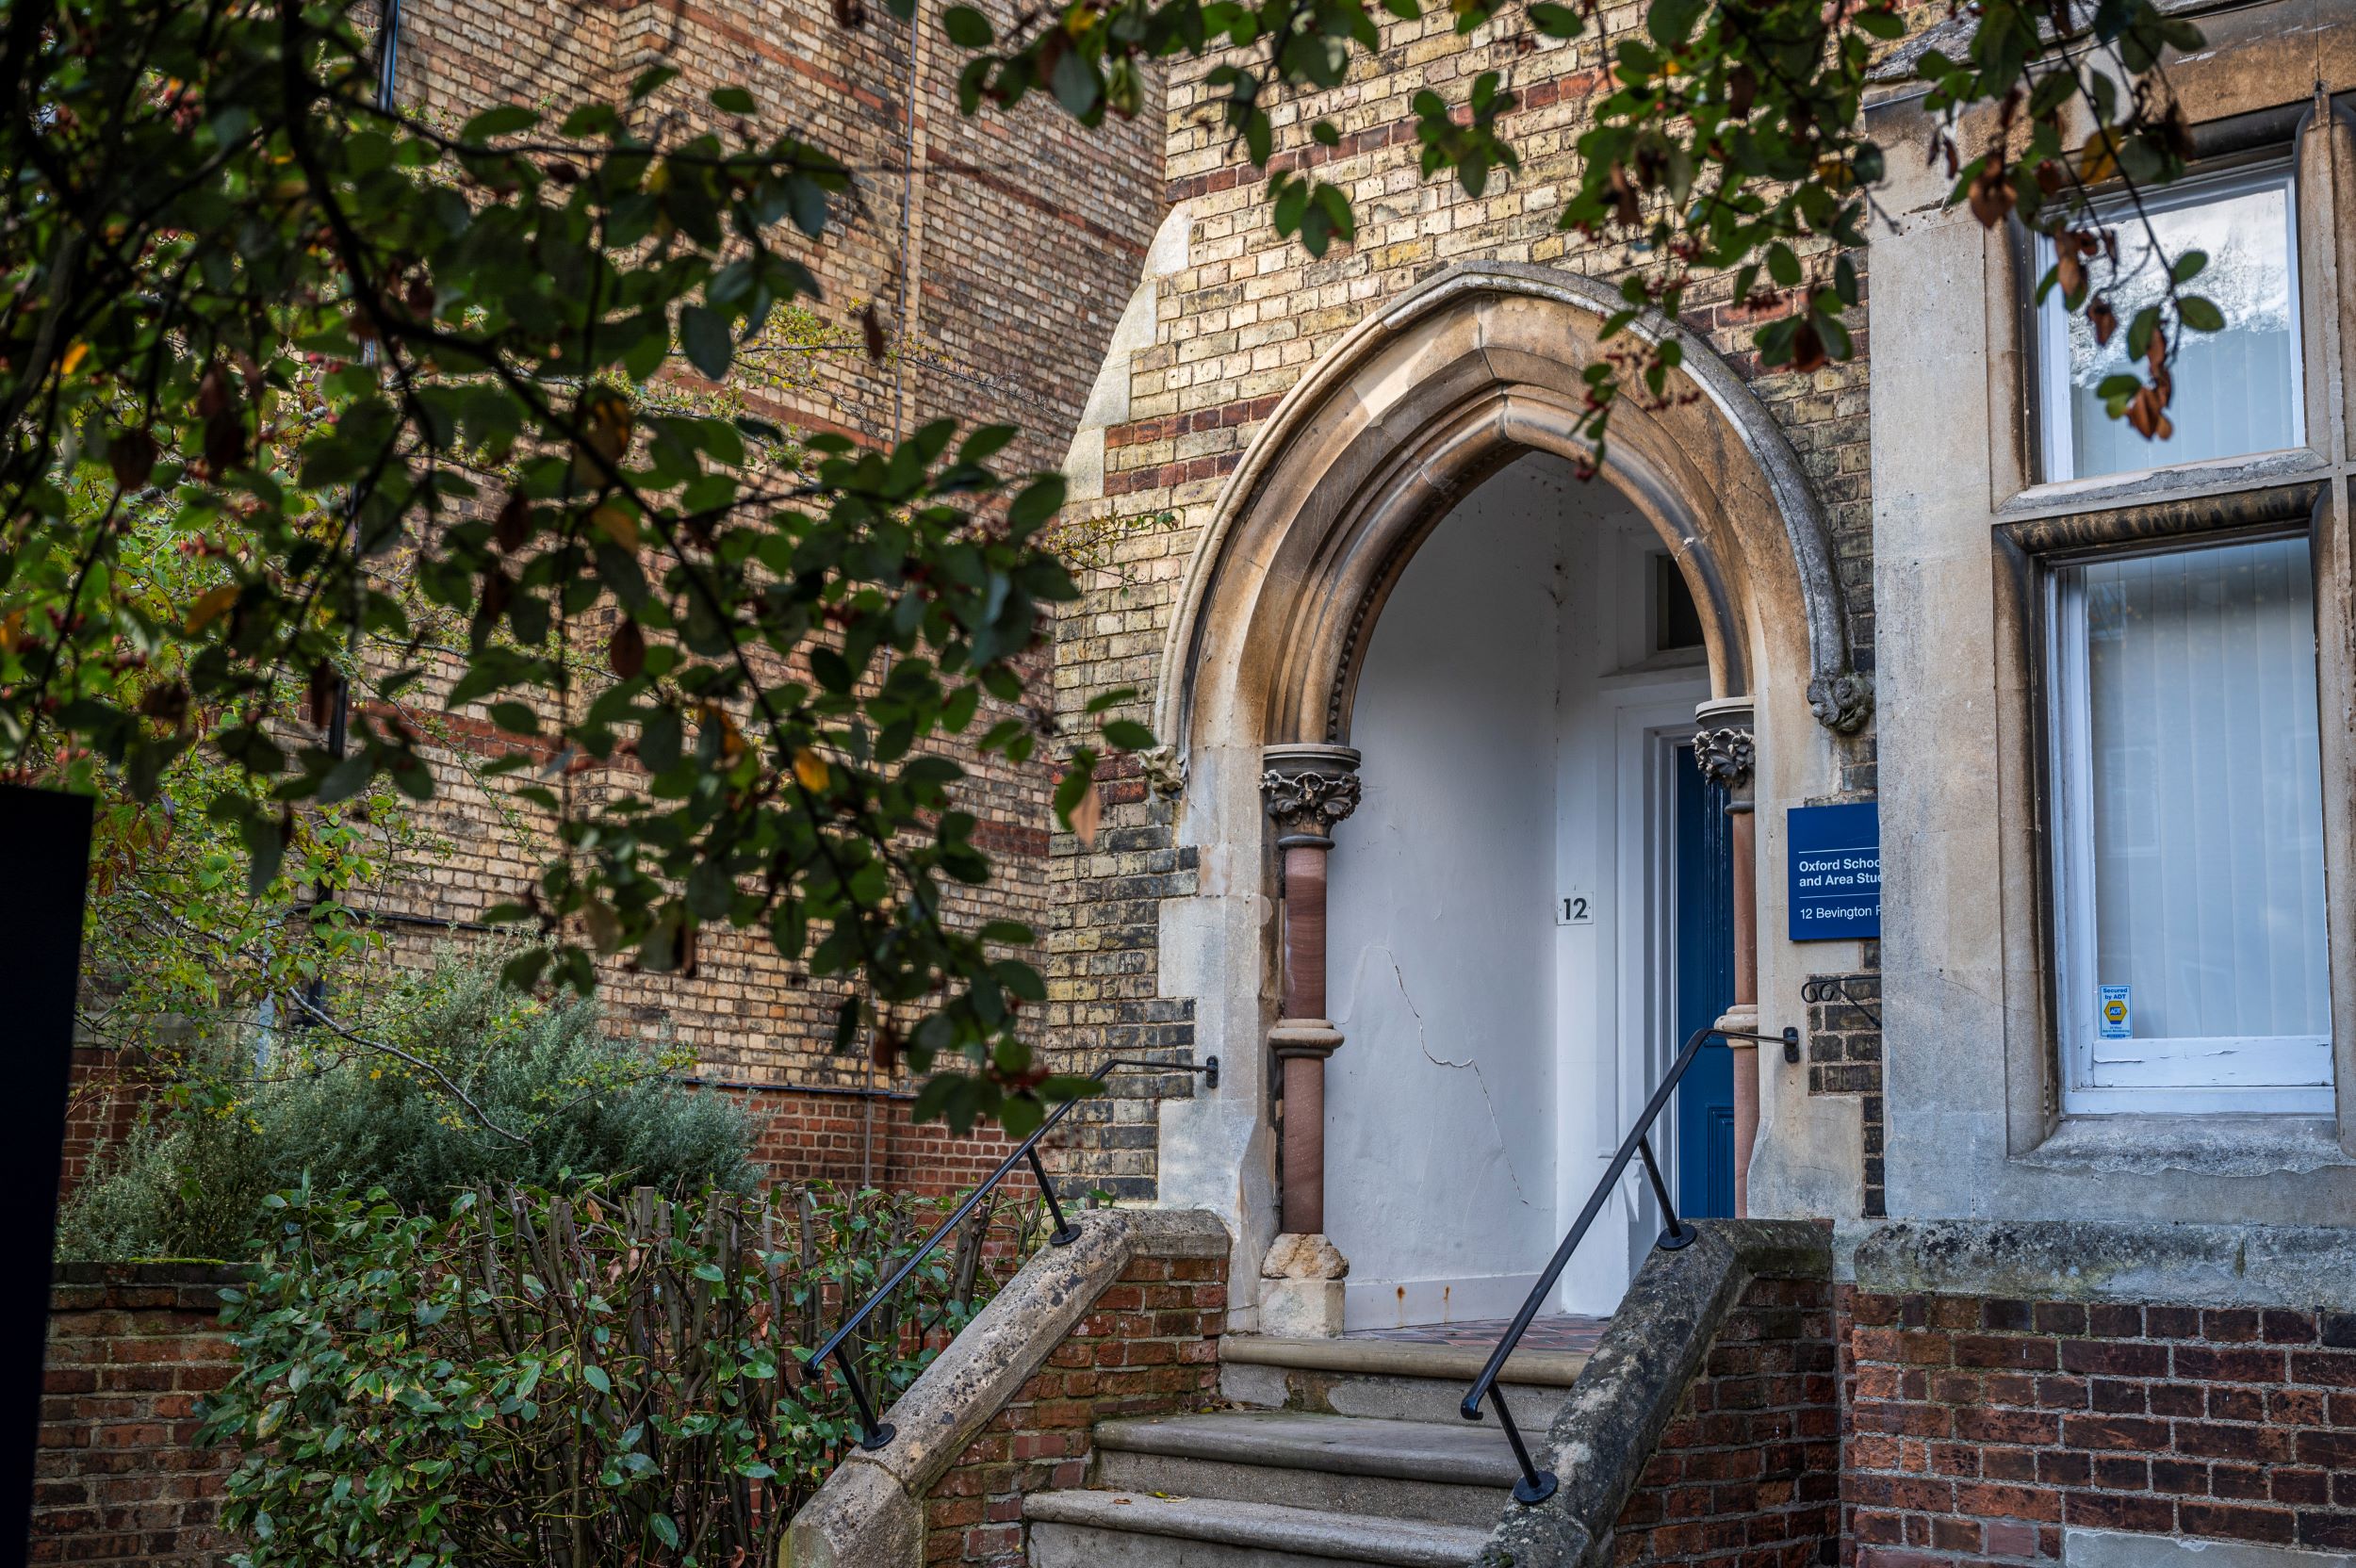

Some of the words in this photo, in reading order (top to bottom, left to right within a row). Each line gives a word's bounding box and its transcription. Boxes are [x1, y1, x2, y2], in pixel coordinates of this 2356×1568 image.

[1799, 858, 1840, 872] Oxford
[1799, 875, 1822, 887] and
[1824, 874, 1854, 886] Area
[1563, 897, 1588, 920] 12
[1800, 907, 1812, 920] 12
[1816, 906, 1872, 920] Bevington
